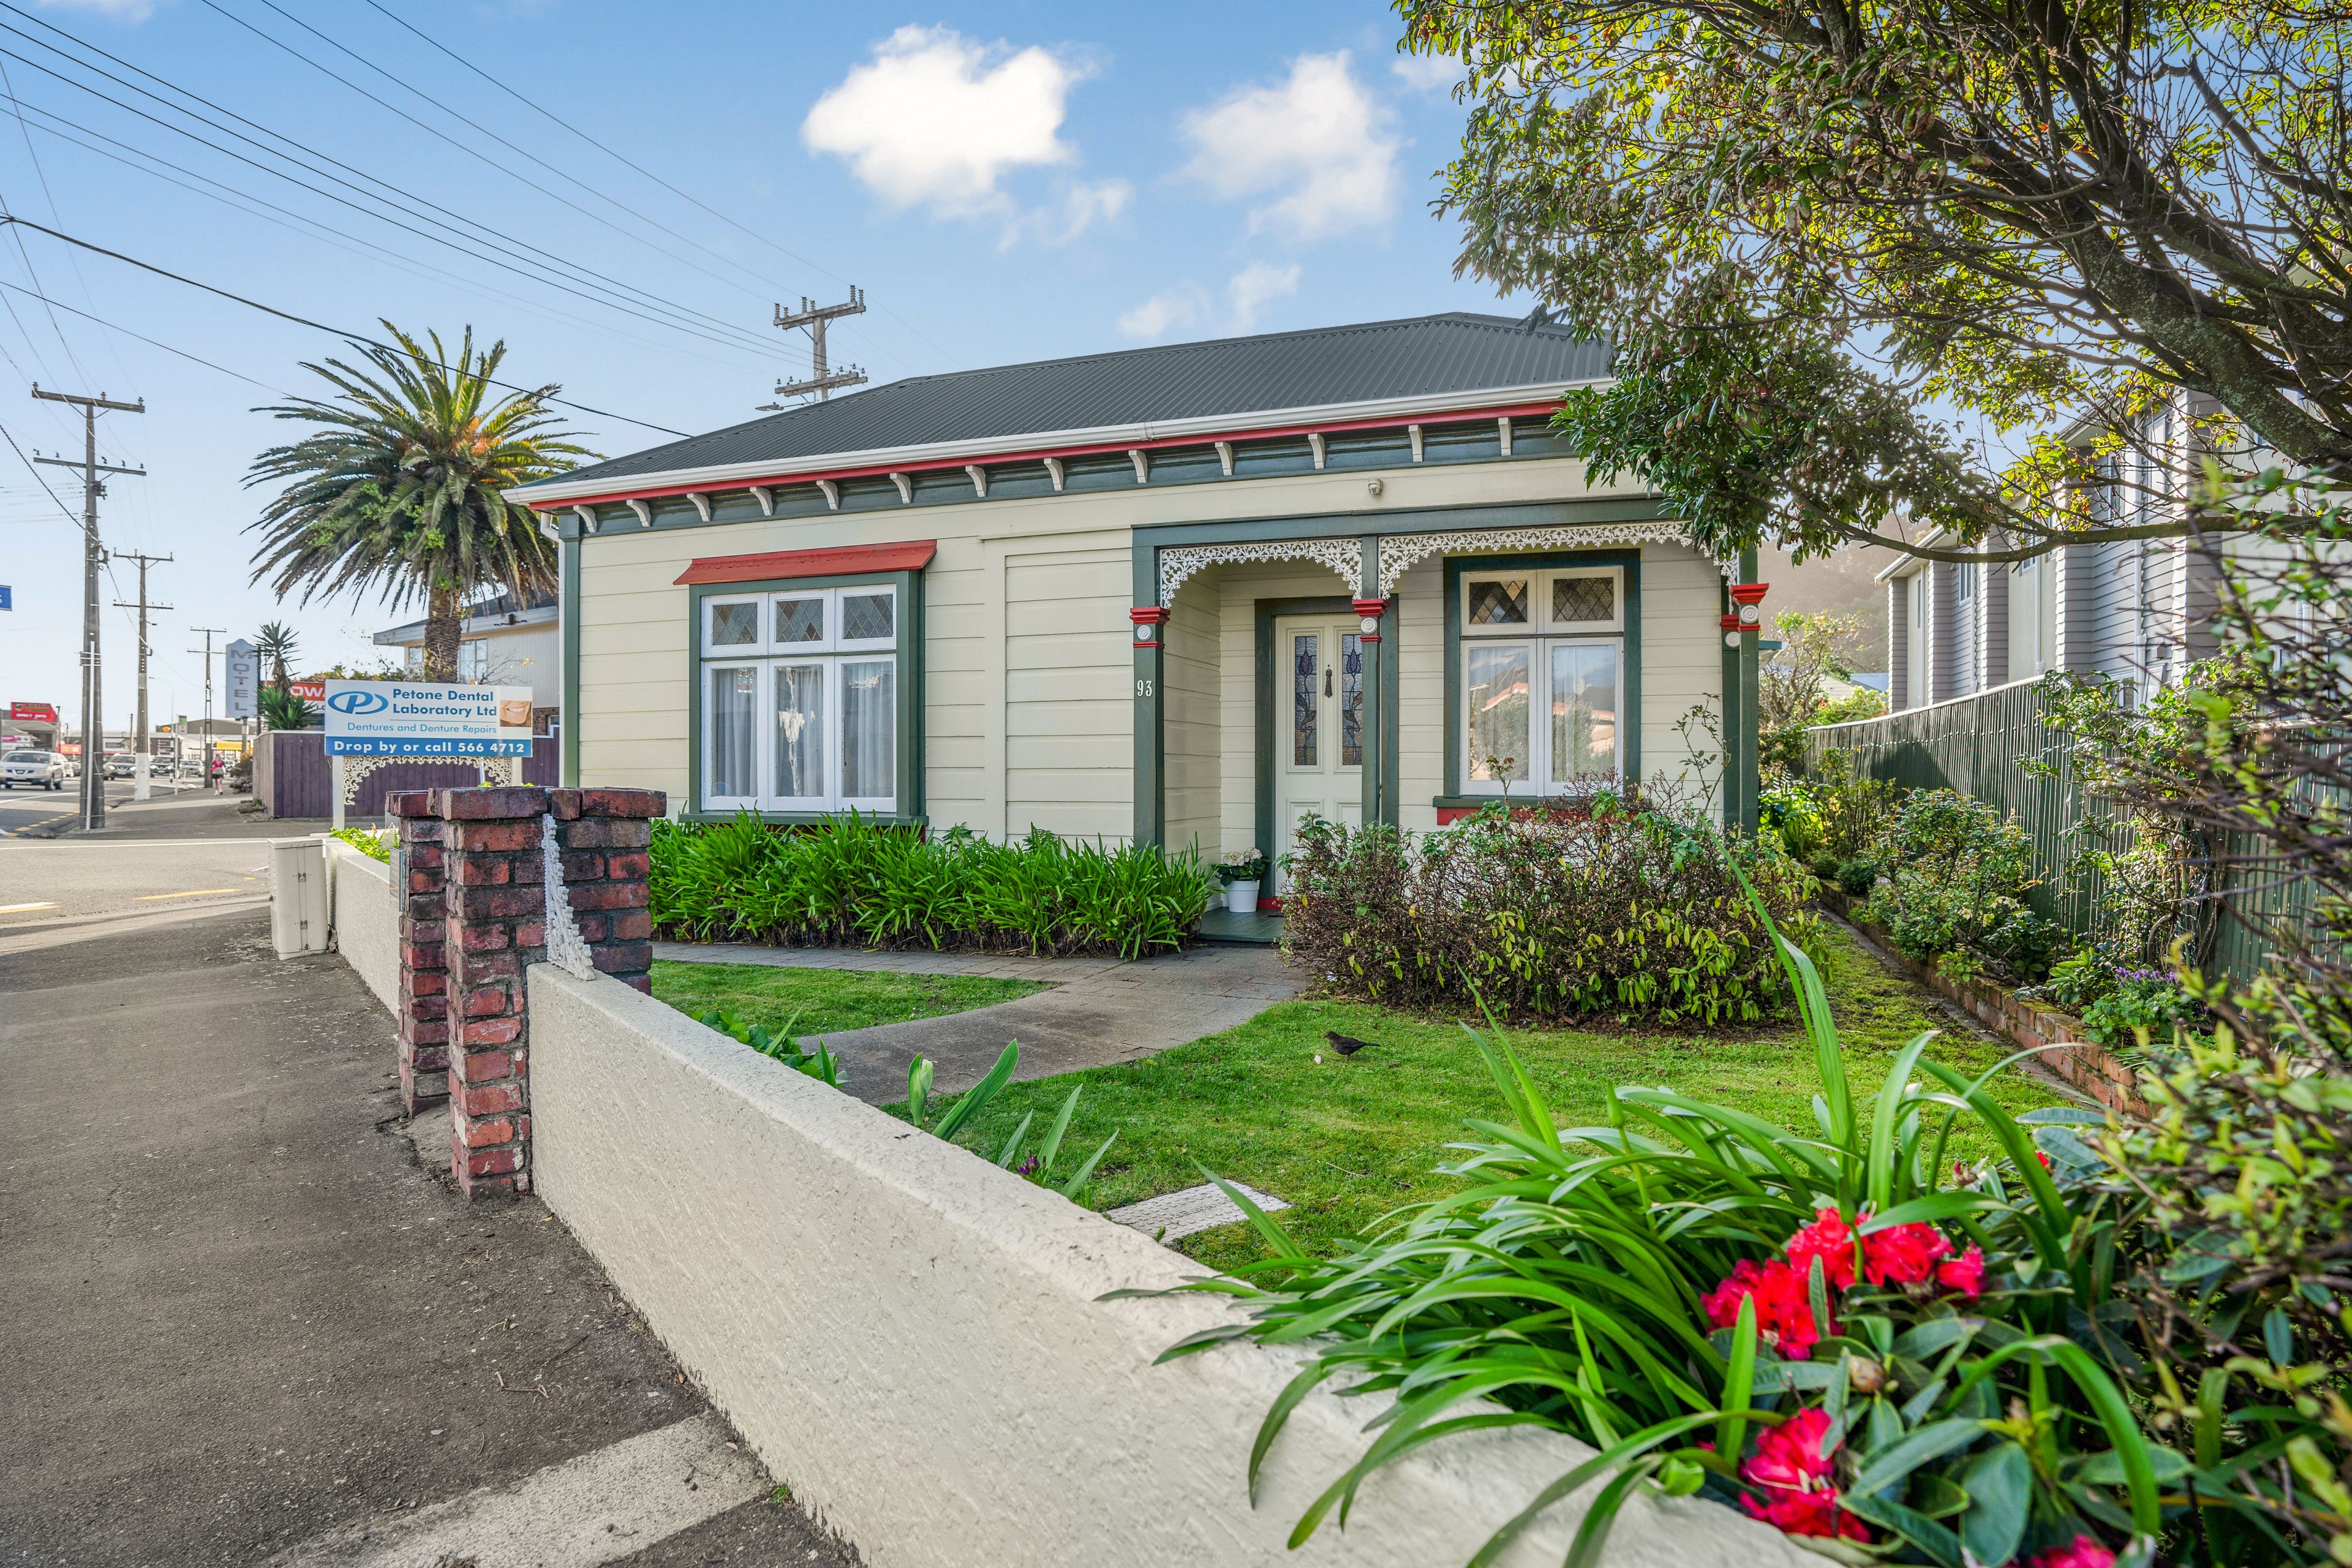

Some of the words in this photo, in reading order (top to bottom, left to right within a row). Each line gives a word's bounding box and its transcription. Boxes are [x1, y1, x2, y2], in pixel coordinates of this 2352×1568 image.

[230, 649, 257, 711] MOTEL
[393, 688, 442, 699] Petone
[448, 690, 493, 701] Dental
[1137, 680, 1152, 696] 93
[393, 704, 472, 718] Laboratory
[477, 706, 497, 715] Ltd
[348, 722, 394, 731] Dentures
[420, 724, 459, 733] Denture
[463, 725, 497, 734] Repairs
[334, 741, 372, 753] Drop
[379, 741, 397, 753] by
[425, 742, 451, 752] call
[458, 742, 484, 752] 566
[490, 742, 524, 753] 4712
